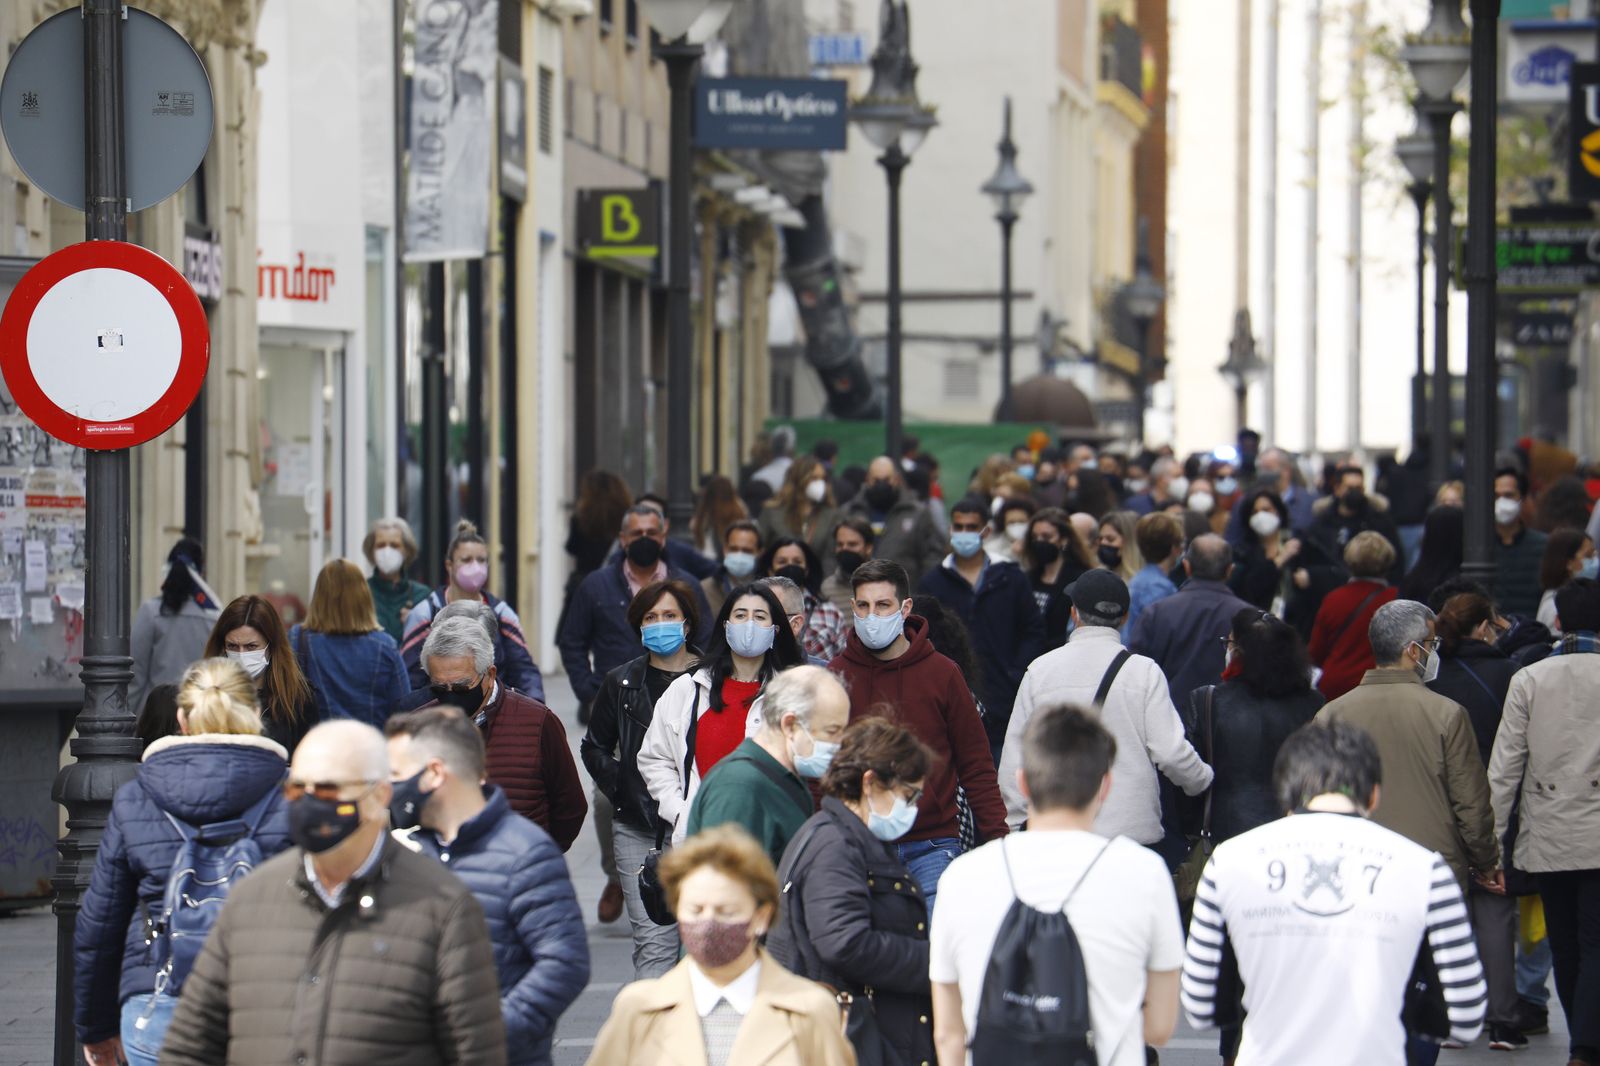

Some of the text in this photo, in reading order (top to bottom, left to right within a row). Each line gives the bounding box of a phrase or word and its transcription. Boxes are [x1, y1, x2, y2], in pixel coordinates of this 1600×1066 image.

[416, 111, 446, 243] MATILDE
[602, 194, 640, 242] B
[1267, 859, 1383, 895] 9 7
